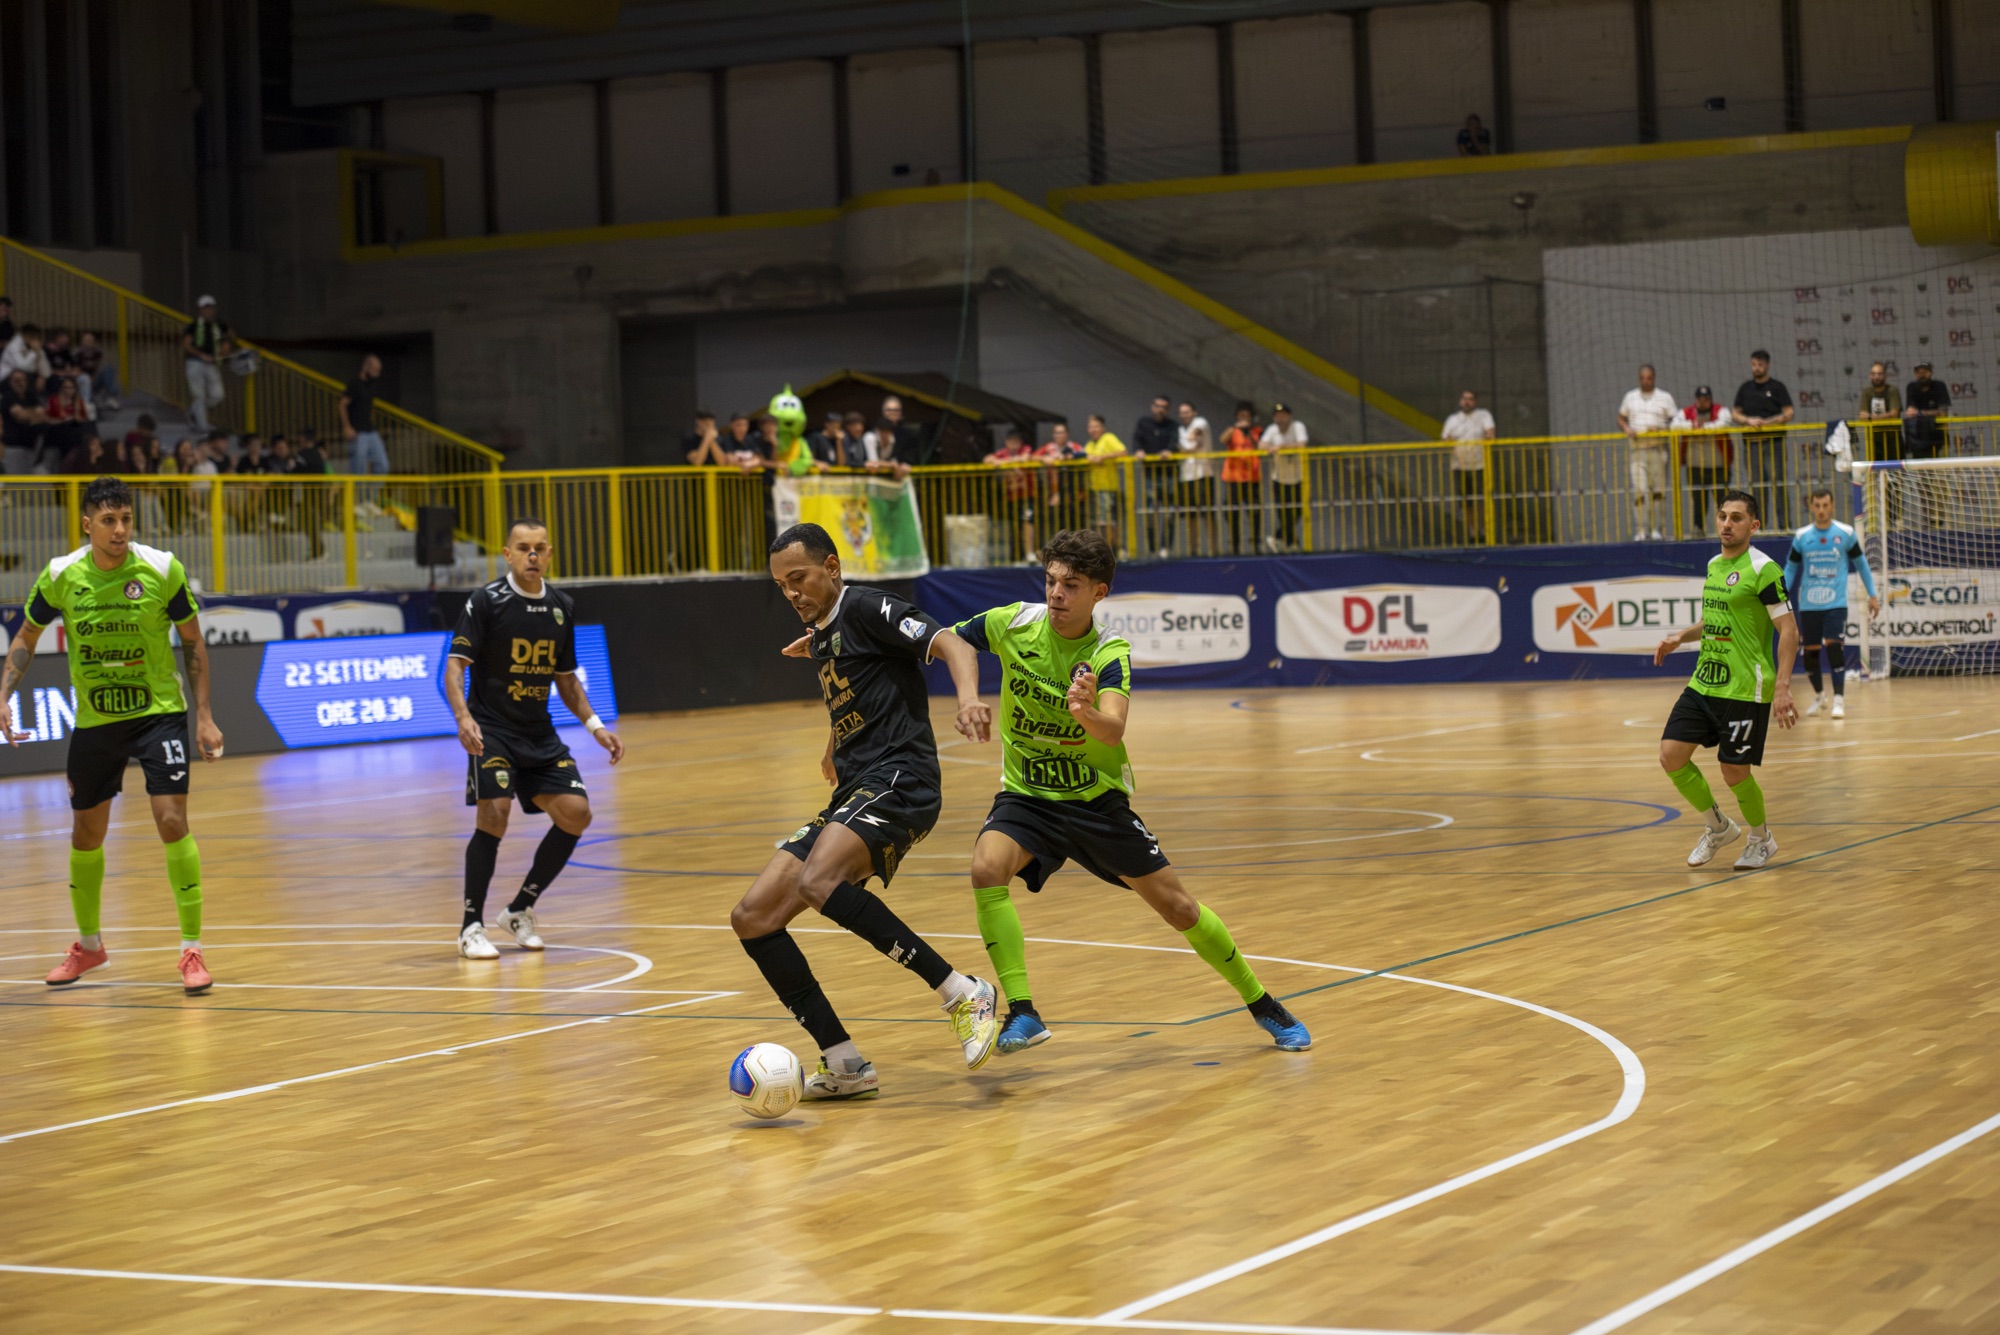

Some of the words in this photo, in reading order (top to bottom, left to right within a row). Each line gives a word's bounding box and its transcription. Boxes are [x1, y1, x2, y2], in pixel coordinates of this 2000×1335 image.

[1343, 595, 1428, 634] DFL
[1705, 597, 1728, 611] sarim
[96, 620, 139, 633] sarim
[1369, 638, 1429, 652] LAMURA
[285, 662, 312, 687] 22
[314, 654, 428, 686] SETTEMBRE
[316, 699, 358, 727] ORE
[1728, 719, 1753, 742] 77
[162, 739, 186, 764] 13
